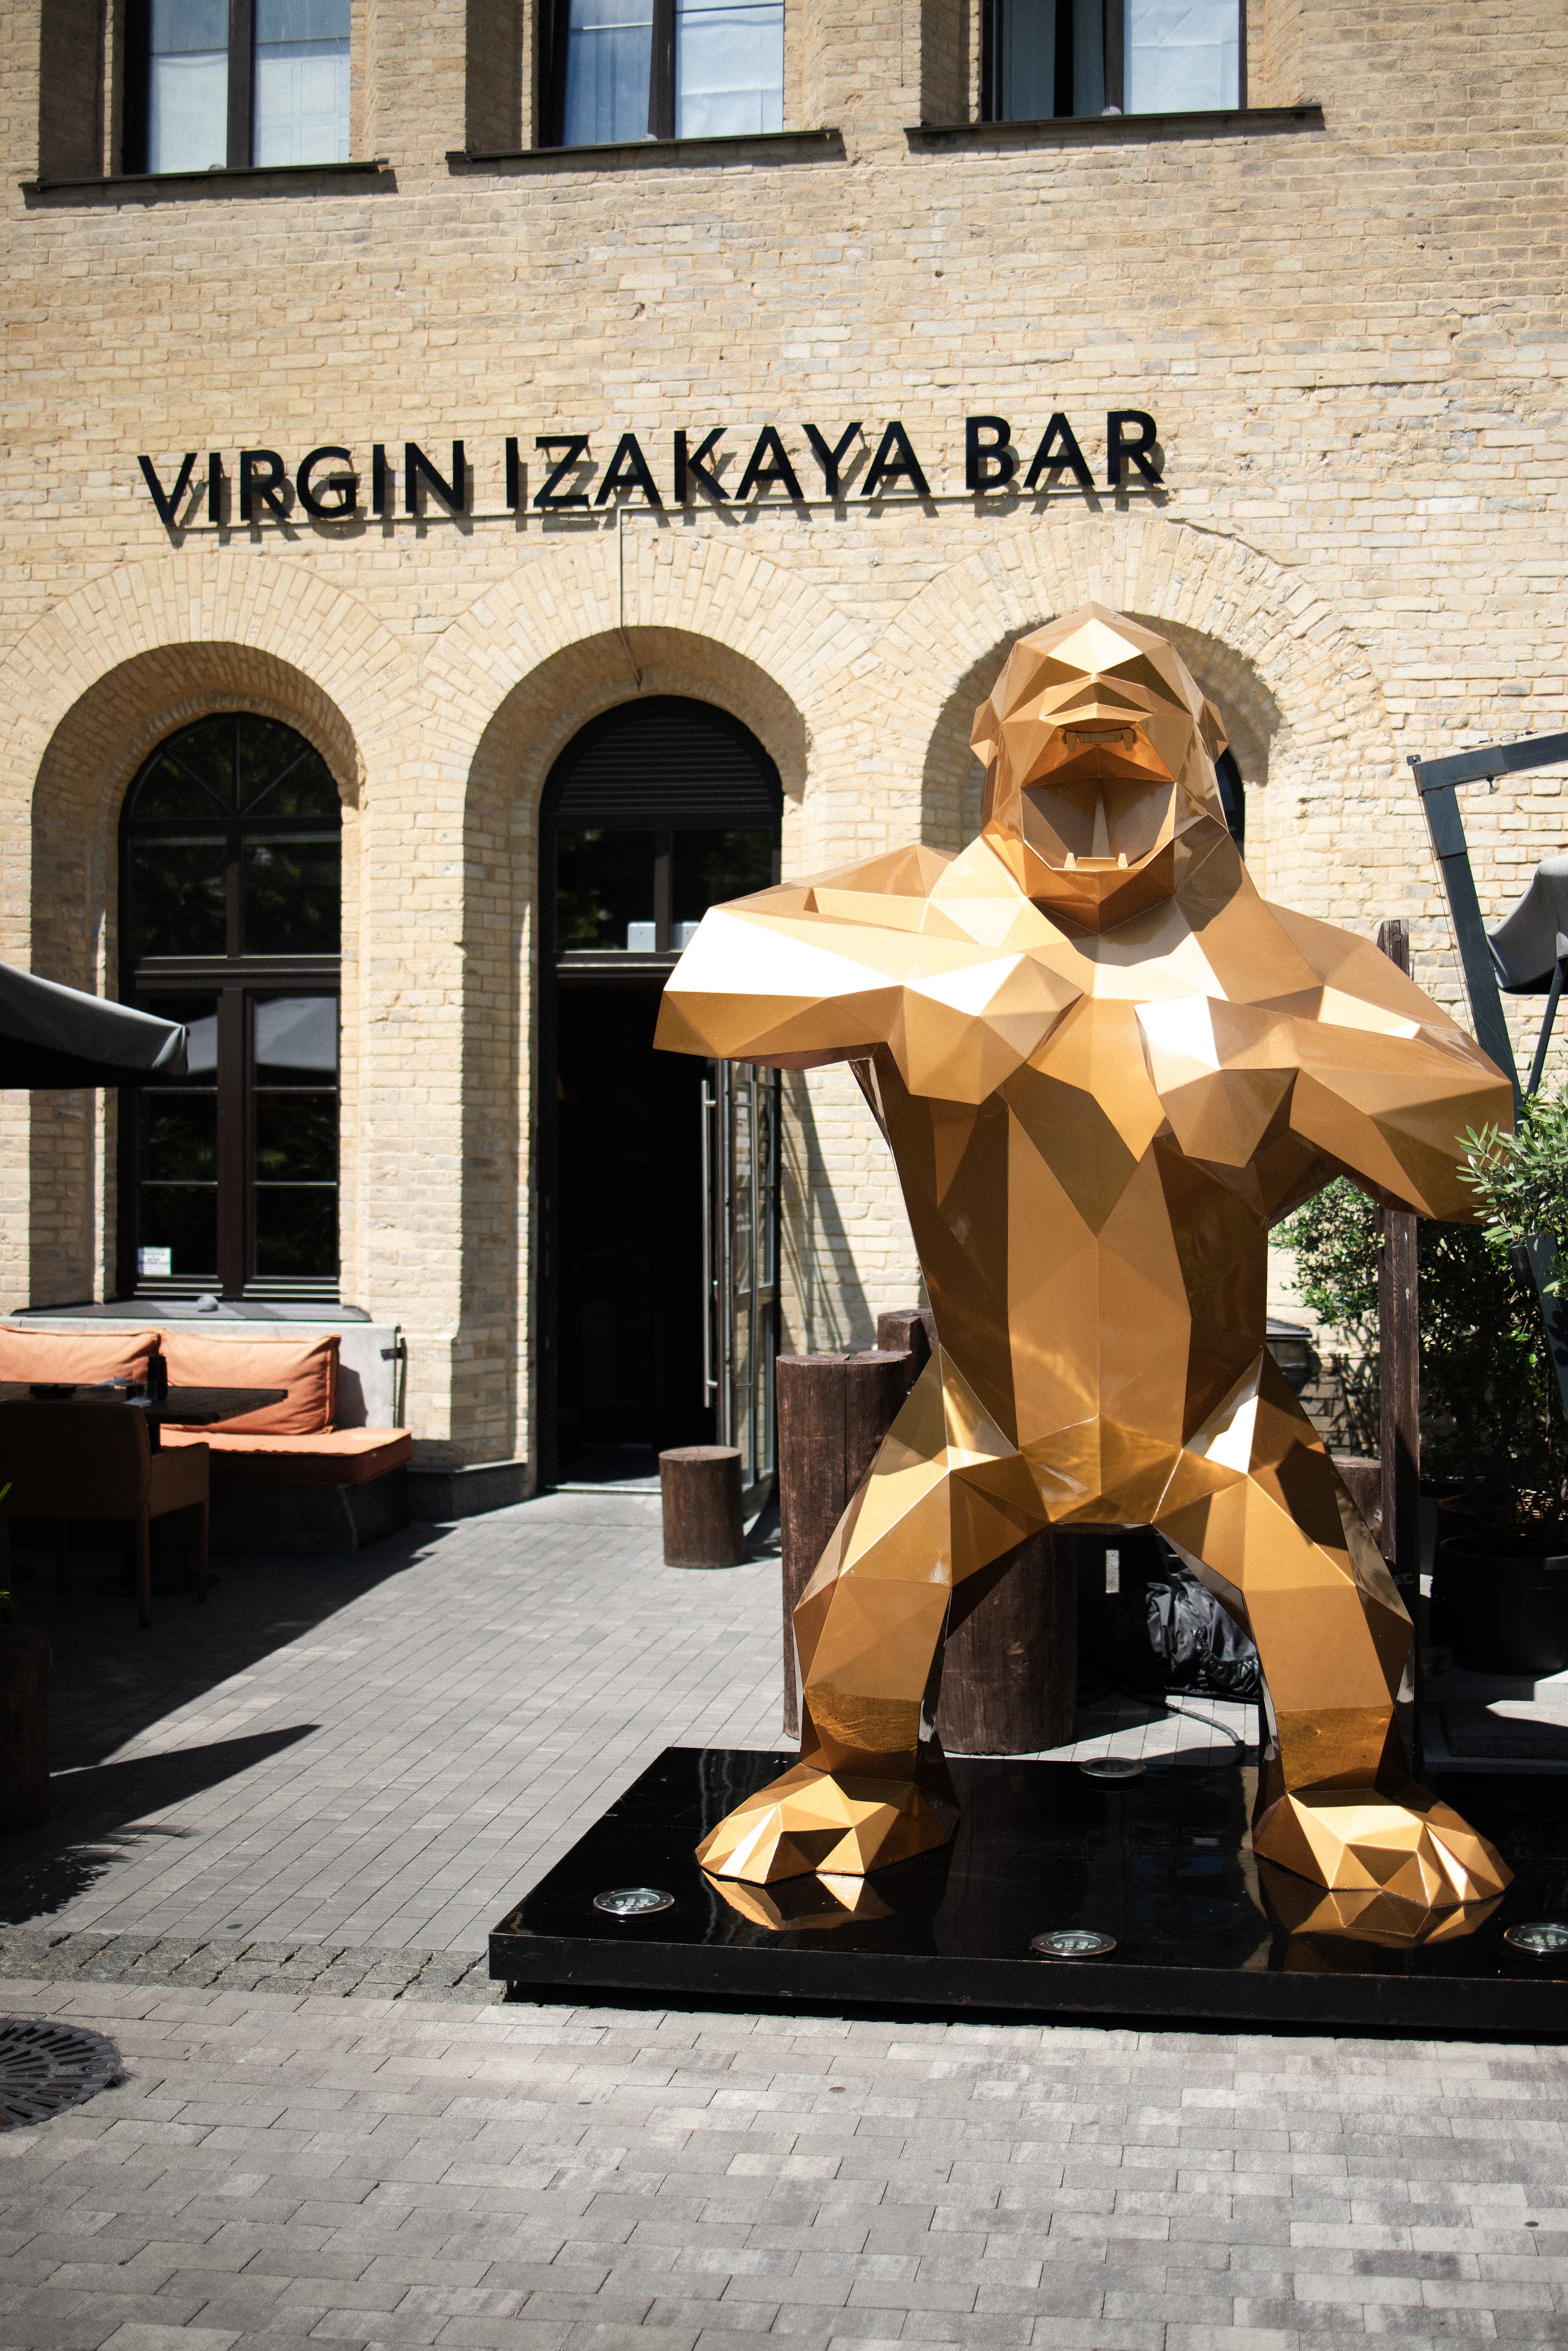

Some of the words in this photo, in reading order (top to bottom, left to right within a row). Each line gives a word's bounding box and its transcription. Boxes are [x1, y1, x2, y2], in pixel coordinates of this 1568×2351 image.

[138, 440, 465, 526] VIRGIN
[506, 421, 931, 509] IZAKAYA
[965, 410, 1165, 490] BAR
